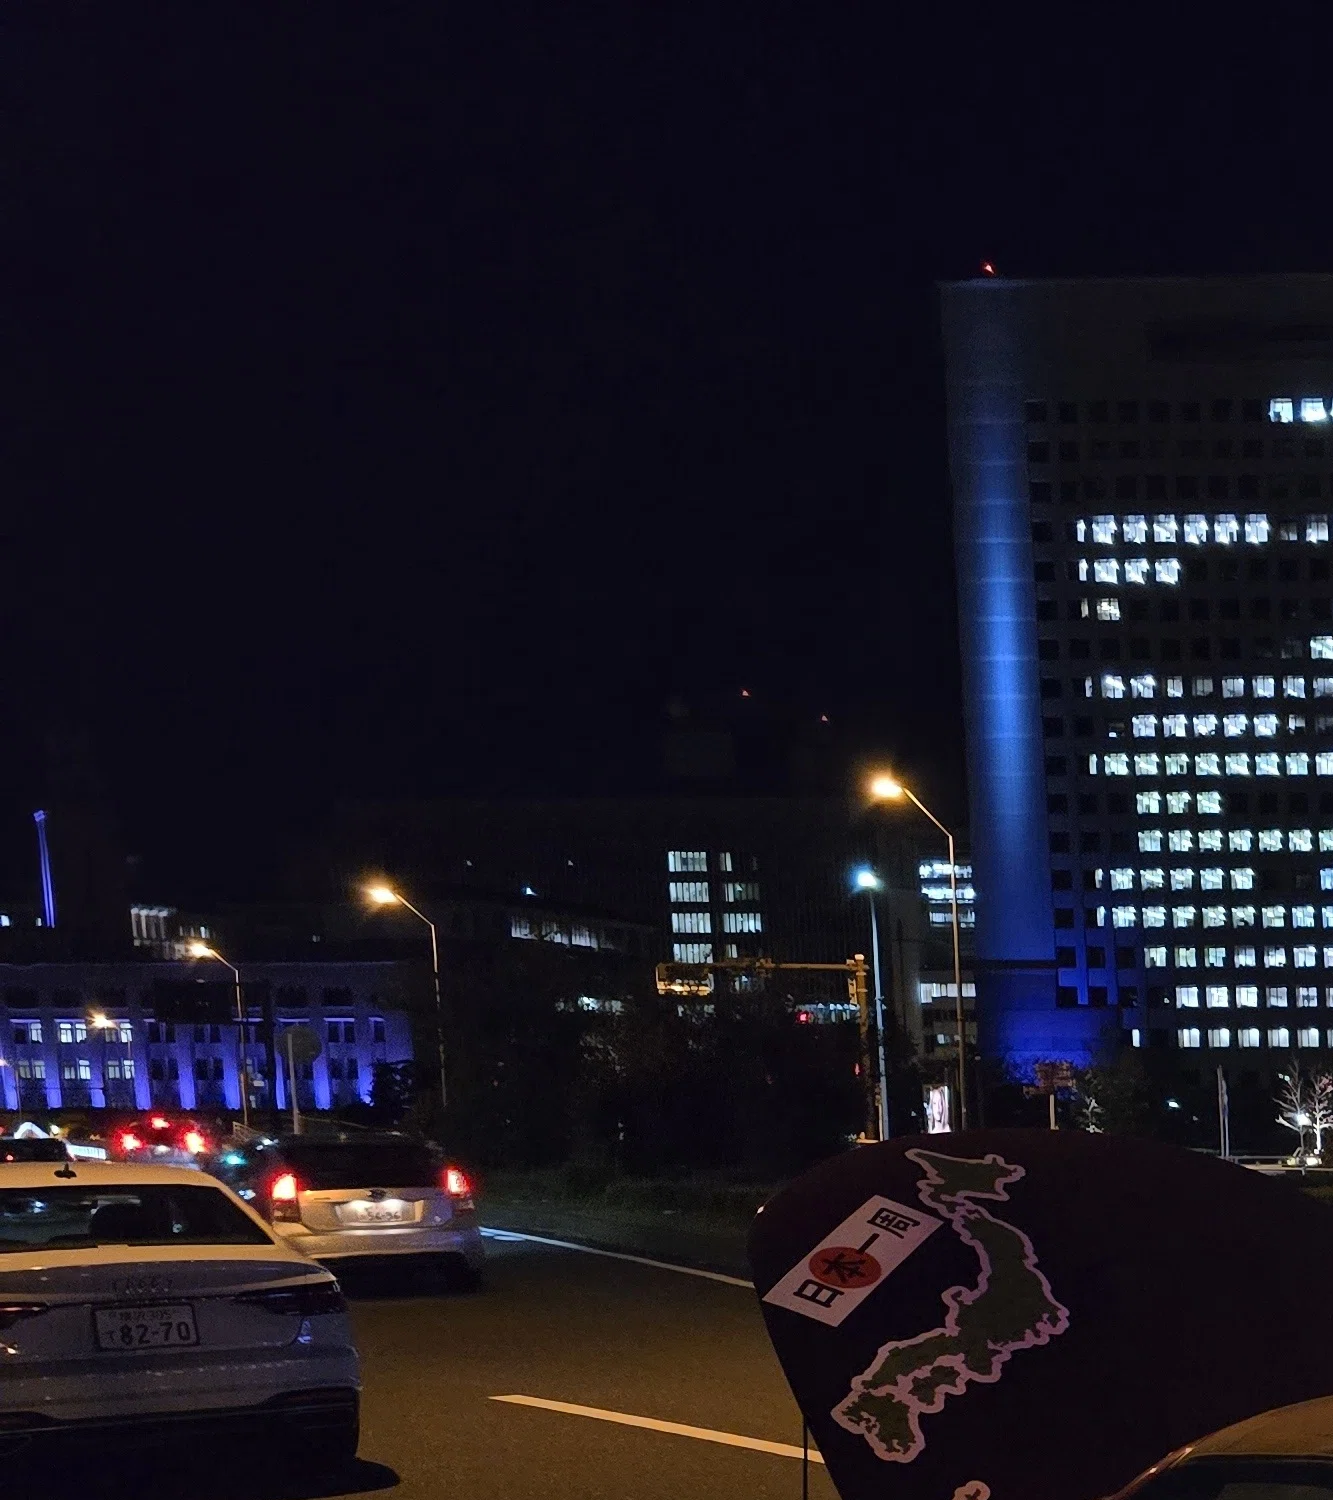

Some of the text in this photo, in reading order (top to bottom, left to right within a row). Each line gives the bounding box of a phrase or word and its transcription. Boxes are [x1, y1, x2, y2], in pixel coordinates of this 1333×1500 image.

[794, 1207, 921, 1307] 日本一周
[119, 1321, 191, 1346] 82-70
